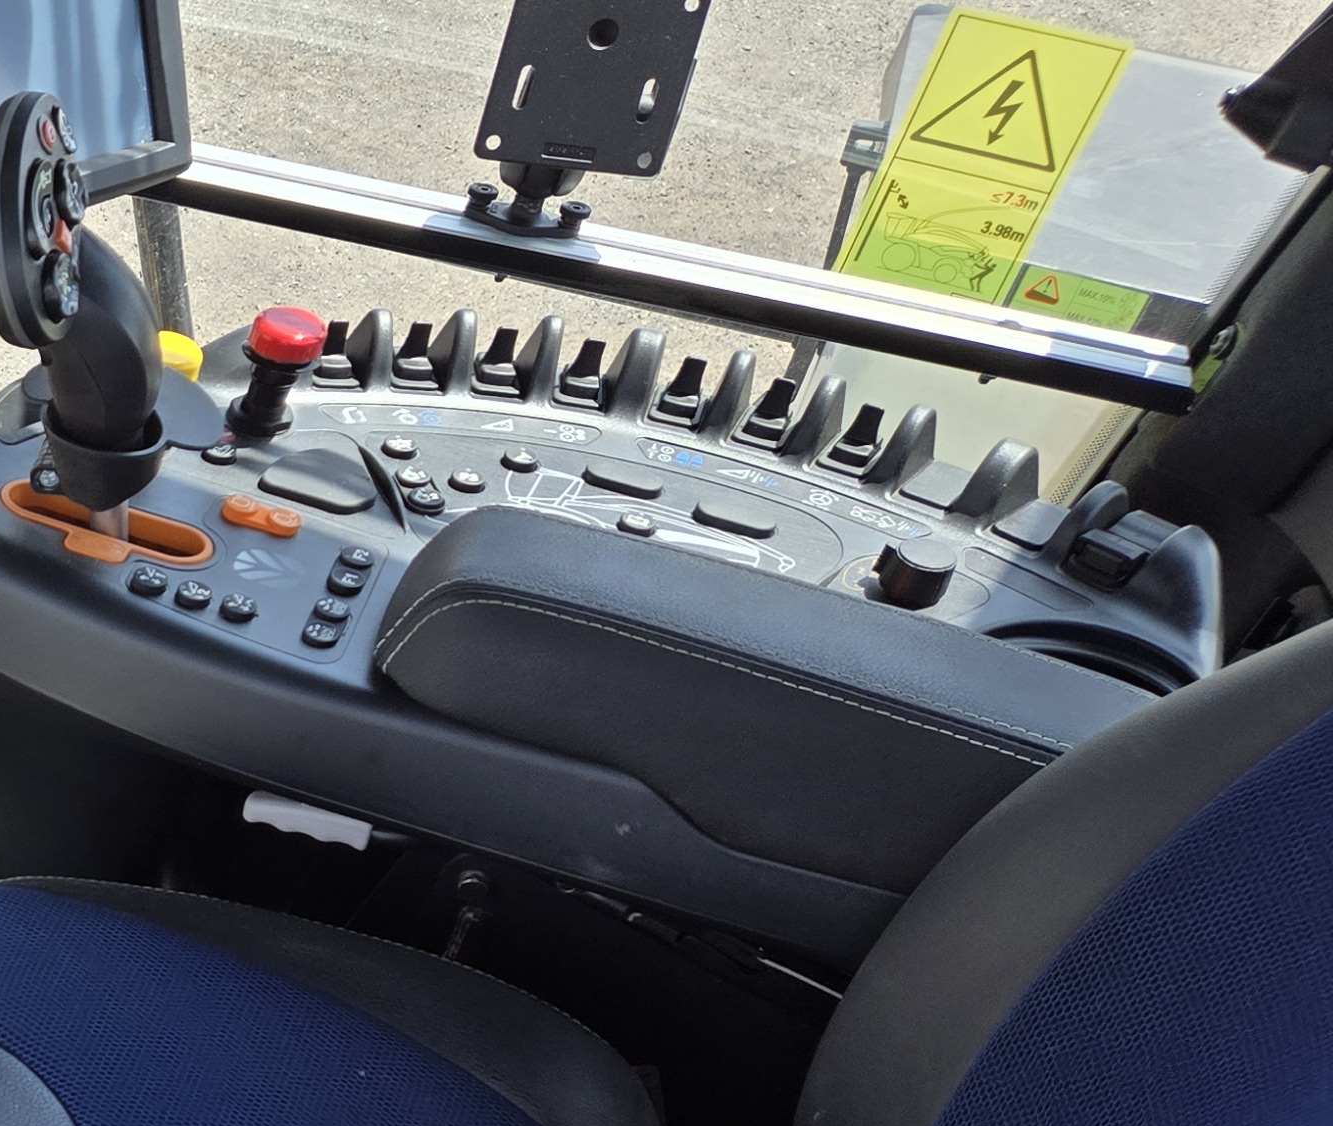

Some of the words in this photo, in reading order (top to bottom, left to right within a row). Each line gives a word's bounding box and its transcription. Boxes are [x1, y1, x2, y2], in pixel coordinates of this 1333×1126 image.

[980, 221, 1025, 242] 3.98m
[352, 549, 369, 561] F2
[341, 572, 359, 585] F1
